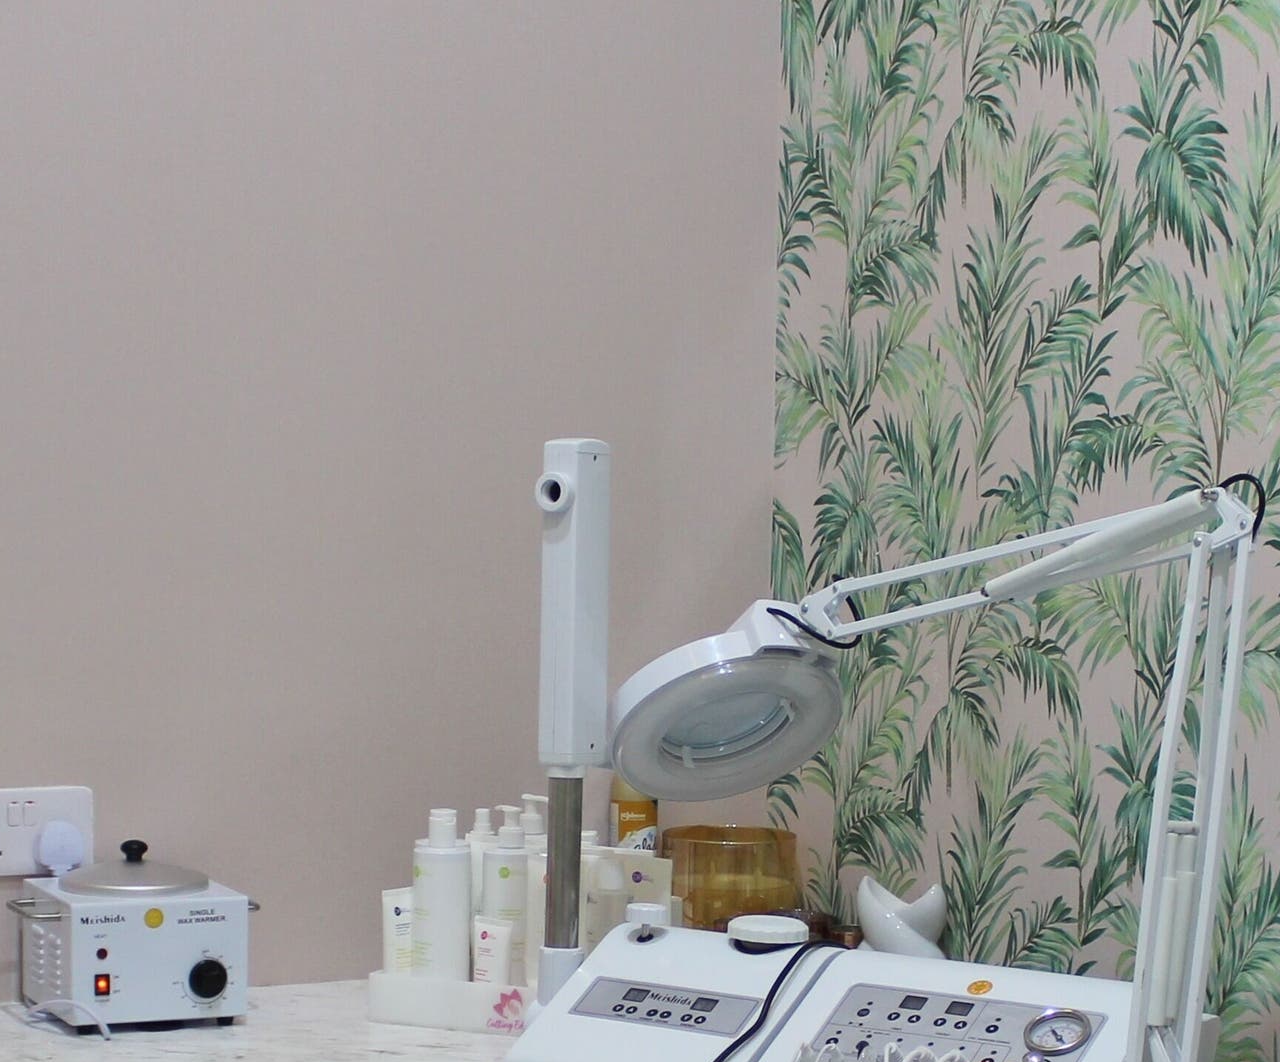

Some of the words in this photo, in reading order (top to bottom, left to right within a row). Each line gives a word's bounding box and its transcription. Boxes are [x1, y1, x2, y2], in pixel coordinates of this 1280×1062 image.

[189, 908, 215, 917] SINGLE
[80, 914, 126, 925] Meishida
[194, 915, 226, 924] WARMER
